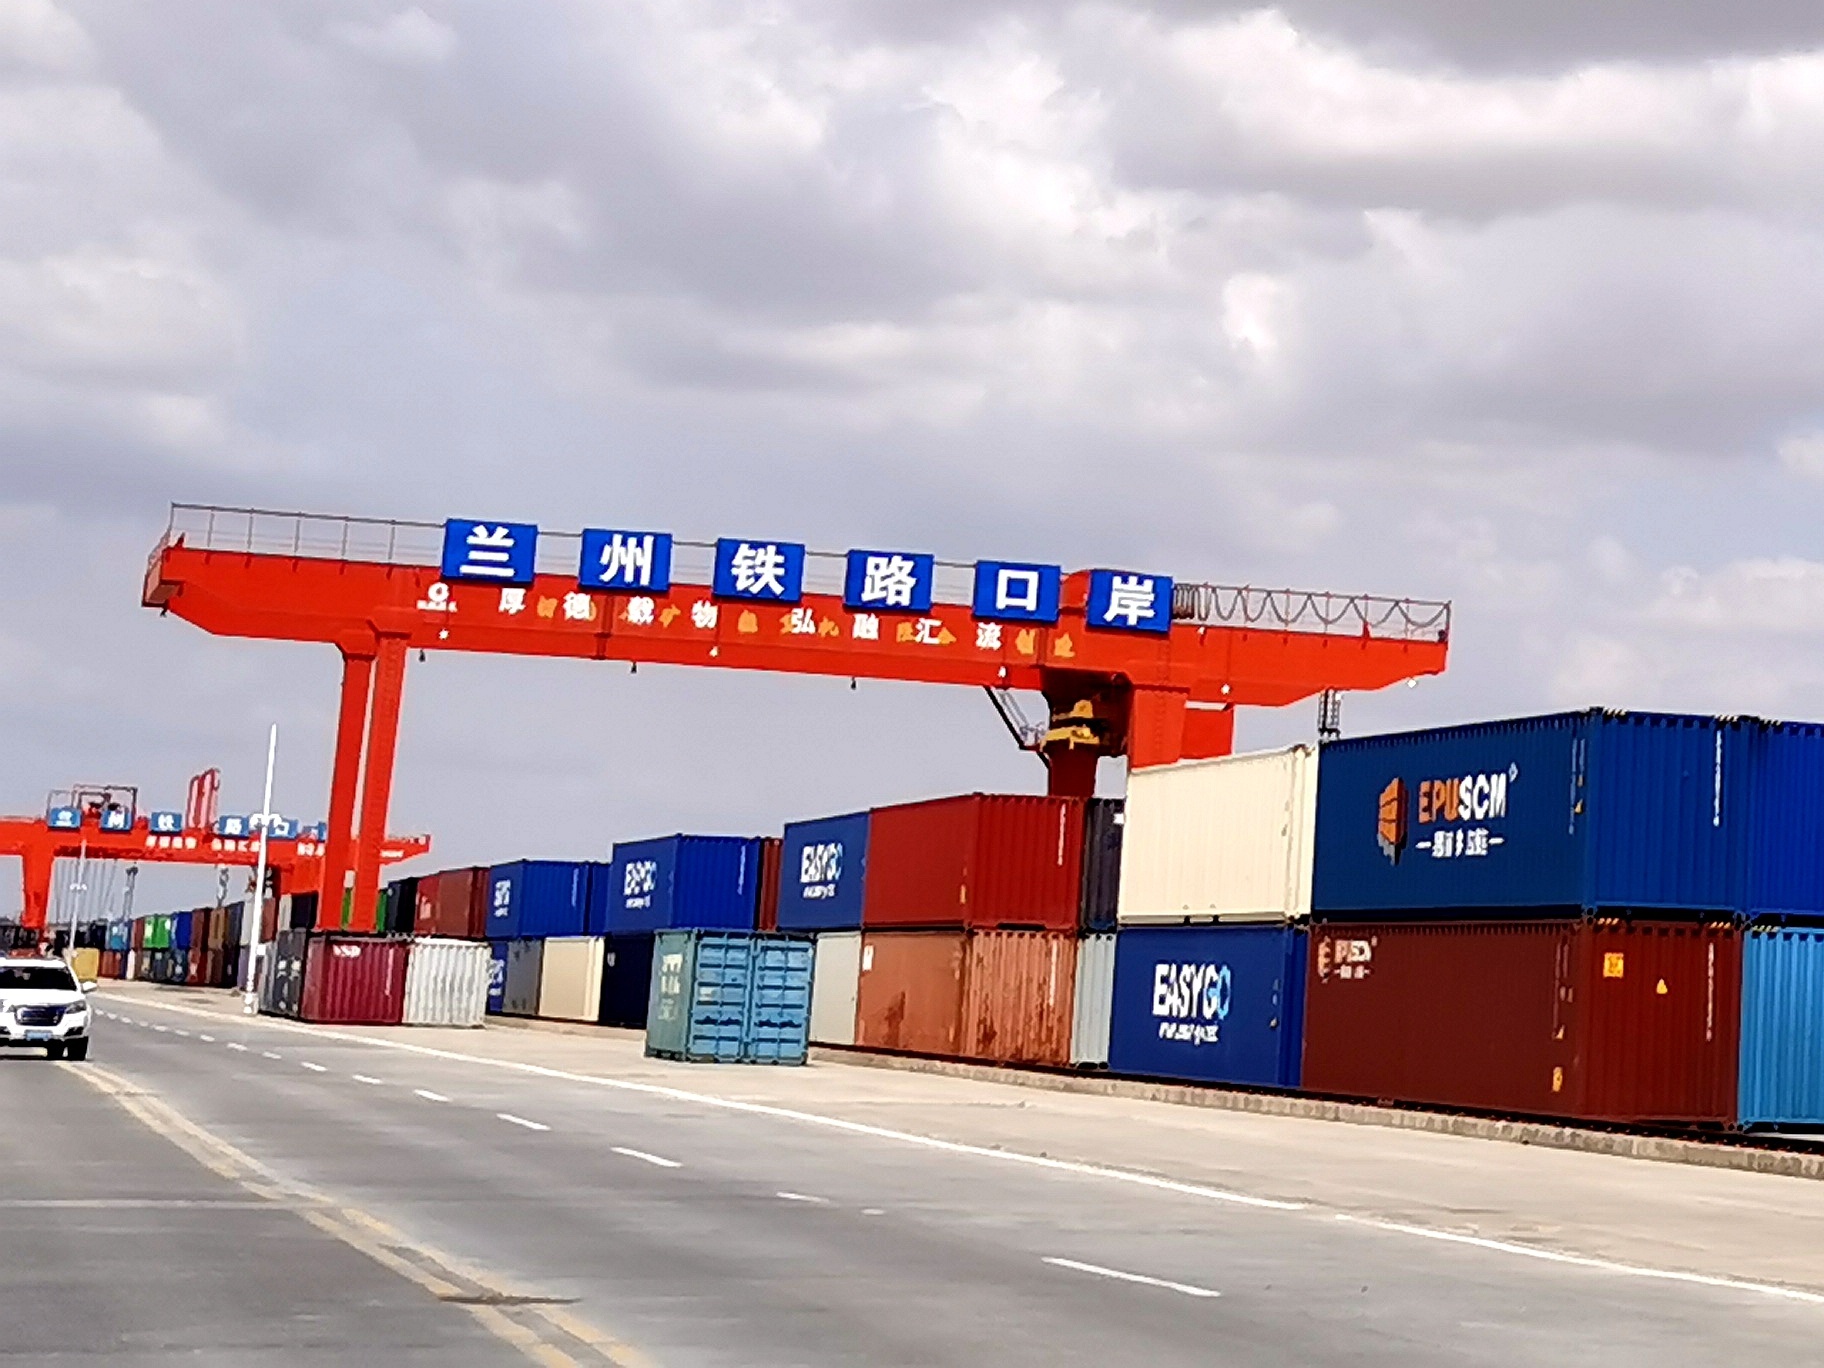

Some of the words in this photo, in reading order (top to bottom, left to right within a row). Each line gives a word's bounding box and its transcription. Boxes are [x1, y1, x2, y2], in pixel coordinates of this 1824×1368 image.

[460, 524, 1155, 625] 兰州铁路口岸
[1418, 772, 1507, 823] EPUSCM
[1152, 963, 1231, 1020] EASYGO
